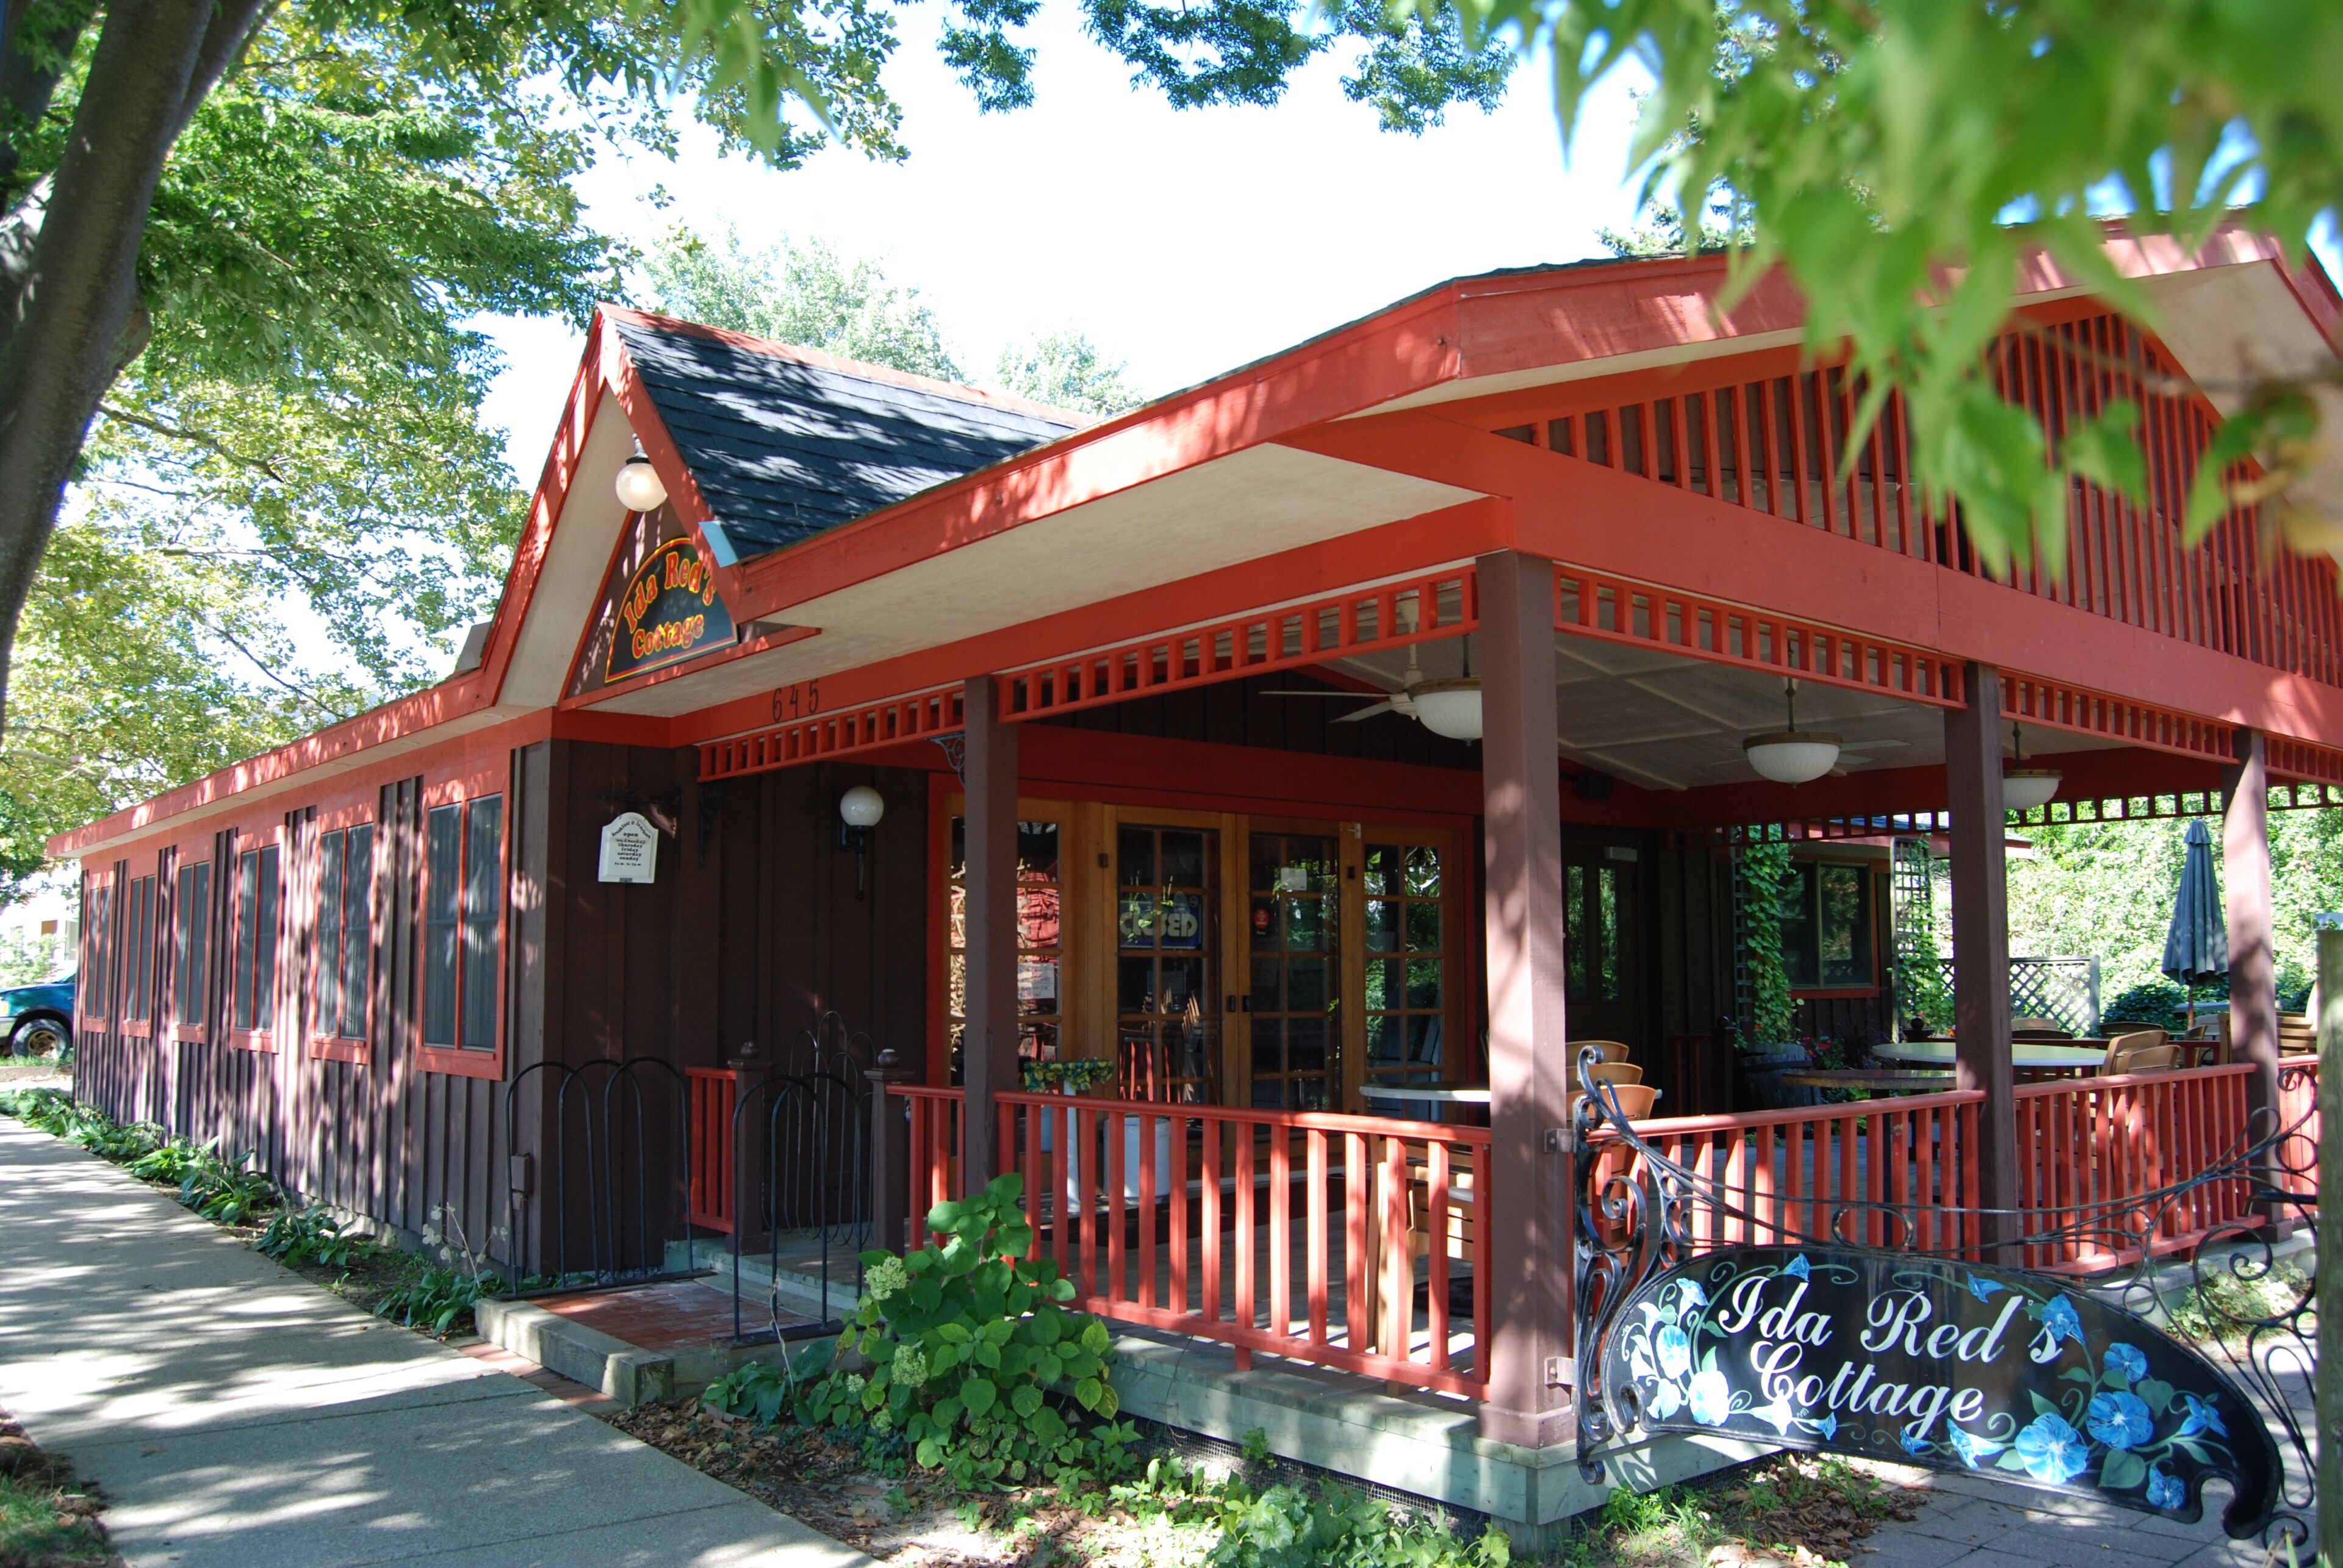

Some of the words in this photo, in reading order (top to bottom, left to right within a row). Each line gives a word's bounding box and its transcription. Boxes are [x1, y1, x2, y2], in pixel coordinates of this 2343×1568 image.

[624, 574, 658, 634] Ida
[664, 552, 717, 606] Red's
[632, 614, 704, 659] Cottage
[772, 678, 819, 722] 645
[1718, 1275, 1833, 1346] Ida
[1750, 1340, 1984, 1439] Cottage
